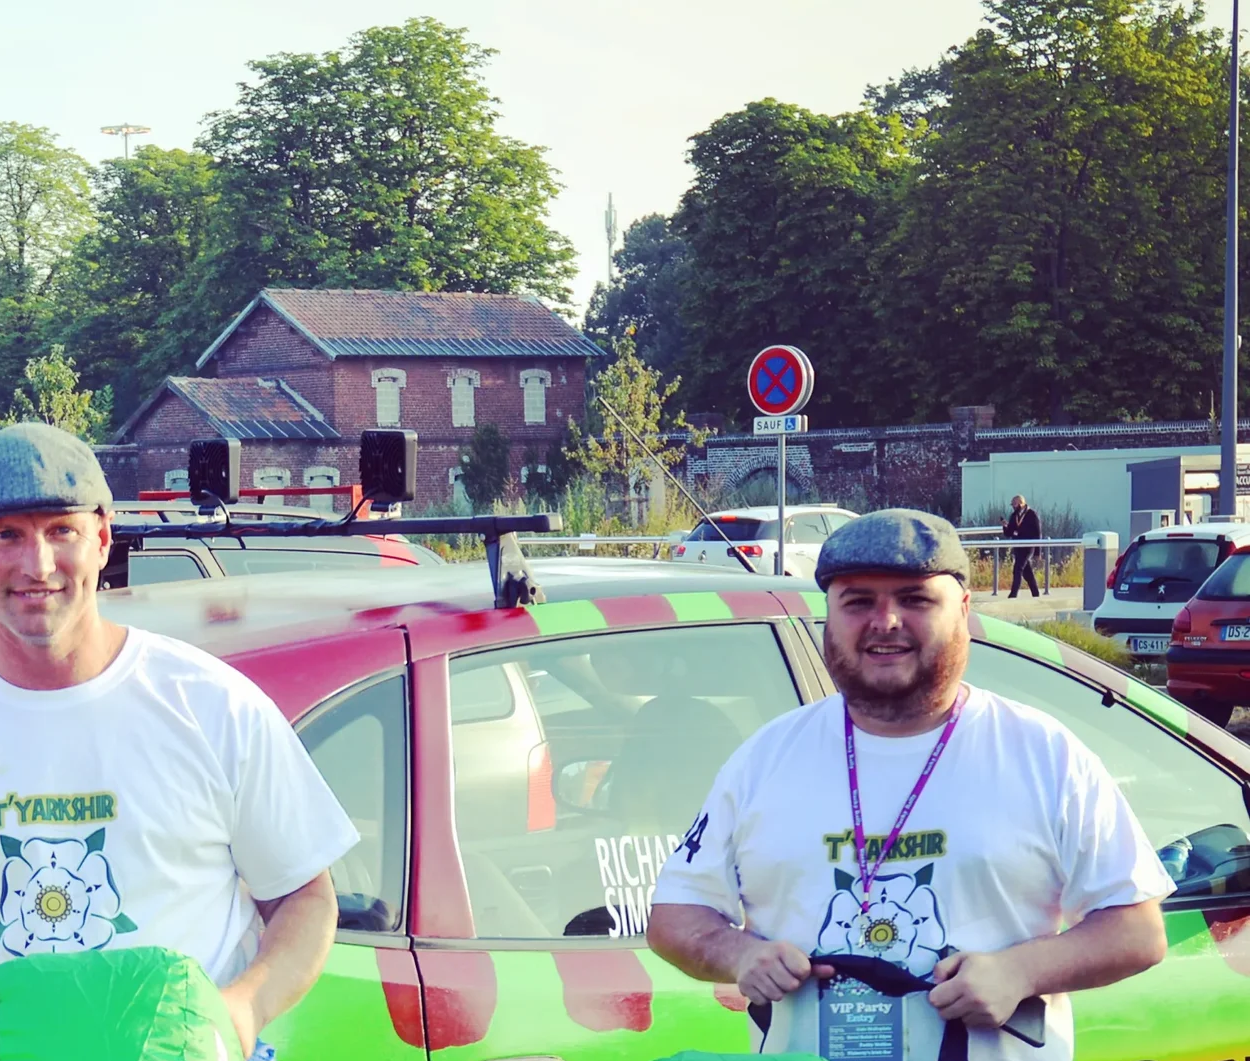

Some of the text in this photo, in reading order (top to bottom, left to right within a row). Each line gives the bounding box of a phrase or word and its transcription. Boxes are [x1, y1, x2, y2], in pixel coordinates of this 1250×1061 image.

[757, 420, 782, 430] SAUF
[674, 812, 709, 864] 4
[595, 835, 686, 887] RICHA
[830, 1002, 892, 1014] VIP Party
[846, 1014, 875, 1023] Entry
